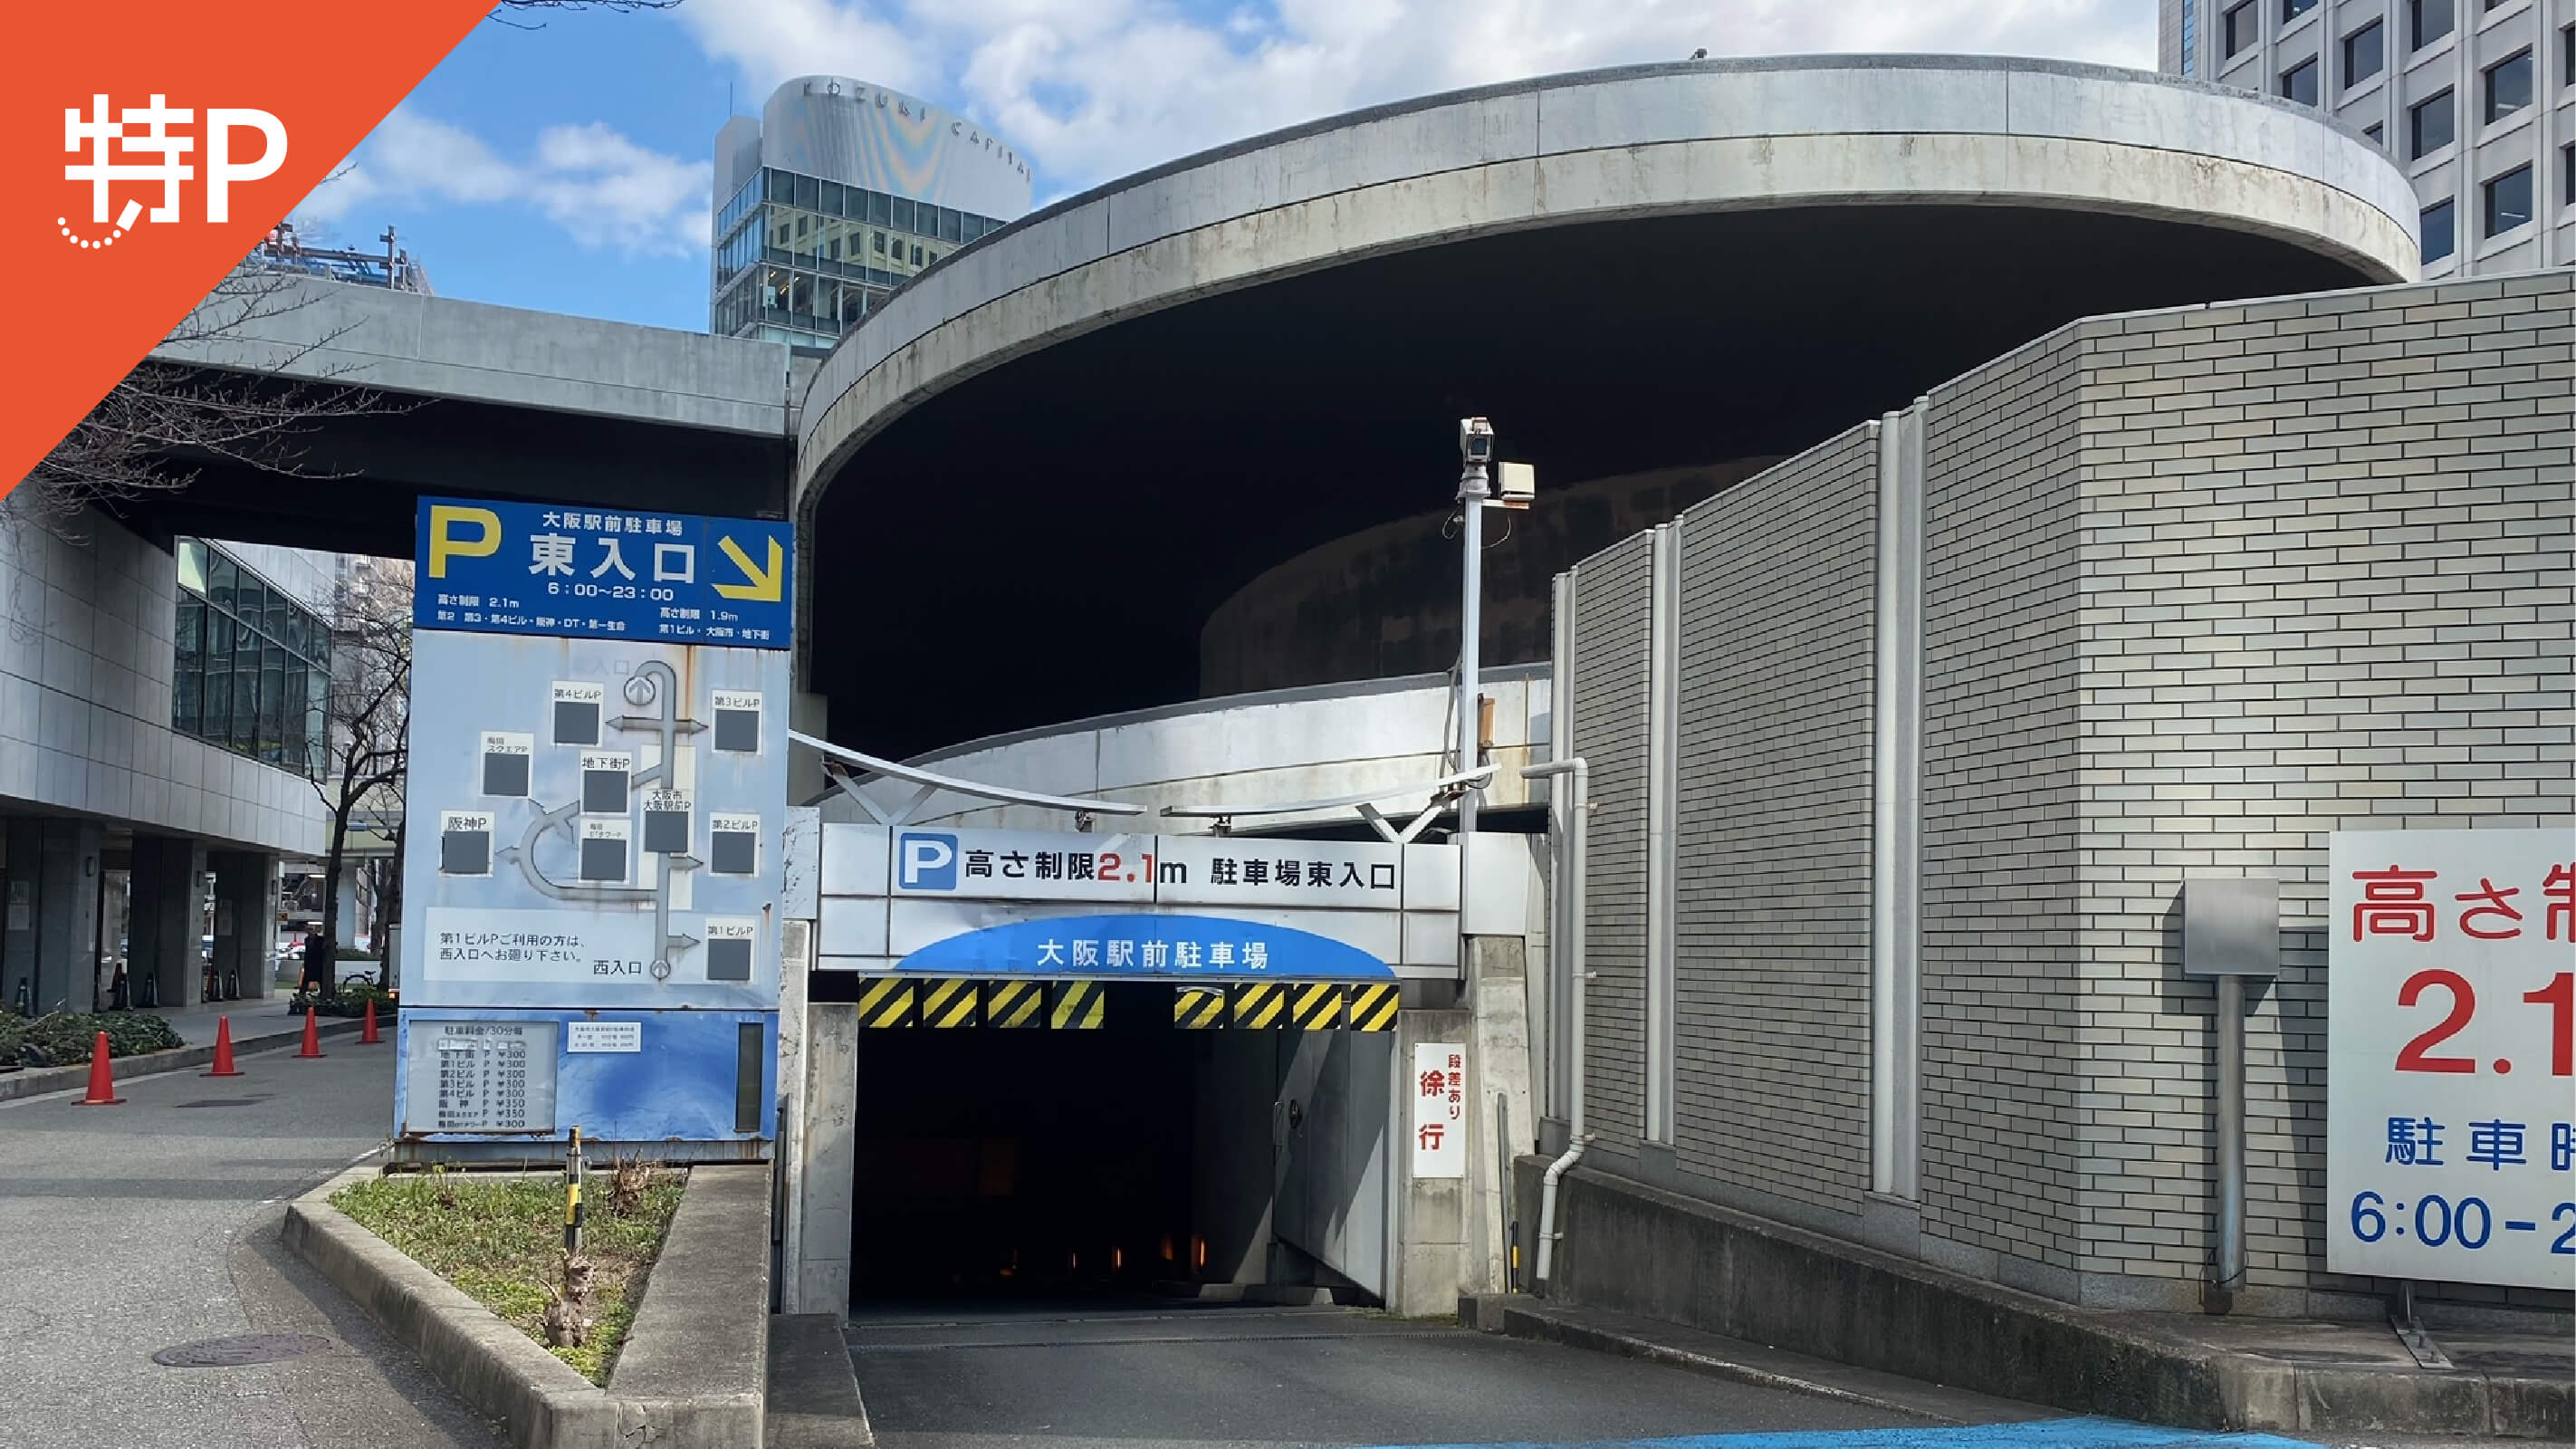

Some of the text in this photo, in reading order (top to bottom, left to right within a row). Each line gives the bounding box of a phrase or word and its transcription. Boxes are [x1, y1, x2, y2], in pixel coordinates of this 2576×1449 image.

[803, 78, 926, 121] KOZUKI
[542, 511, 683, 536] 大阪駅前駐車場
[428, 505, 502, 579] P
[528, 533, 694, 584] 東入口
[437, 594, 520, 609] 高さ制限 2.1m
[660, 608, 739, 622] 高さ制限 1.9m
[554, 688, 601, 700] 第4ビルP
[715, 696, 760, 707] 第3ビルP
[581, 757, 630, 769] 地下街P
[652, 791, 683, 801] 大阪市
[447, 817, 487, 830] 阪神P
[713, 820, 758, 830] 第2ビルP
[905, 840, 952, 883] P
[1211, 858, 1395, 889] 駐車場東入口
[707, 926, 753, 936] 第1ビルP
[1037, 939, 1268, 969] 大阪駅前駐車場
[593, 960, 642, 975] 西入口
[2395, 969, 2574, 1076] 2.1
[1448, 1054, 1461, 1119] 段差あり
[1419, 1070, 1445, 1150] 徐行
